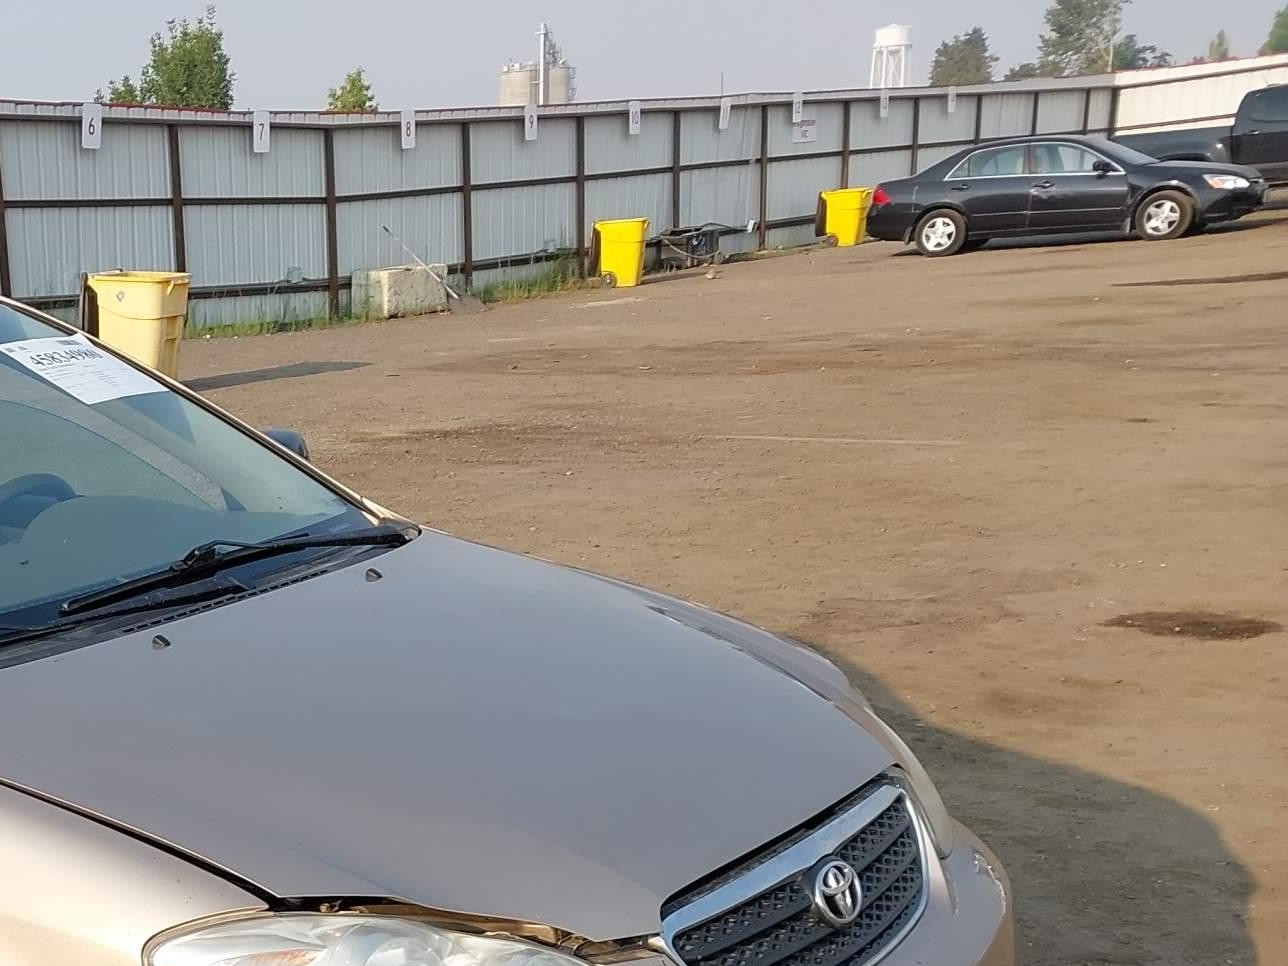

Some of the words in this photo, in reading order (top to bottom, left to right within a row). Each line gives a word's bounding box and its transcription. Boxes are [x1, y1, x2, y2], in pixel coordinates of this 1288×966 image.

[529, 115, 534, 128] 9
[631, 110, 639, 125] 10
[88, 117, 96, 136] 6
[259, 123, 265, 141] 7
[406, 121, 412, 137] 8
[29, 348, 104, 367] 45834980
